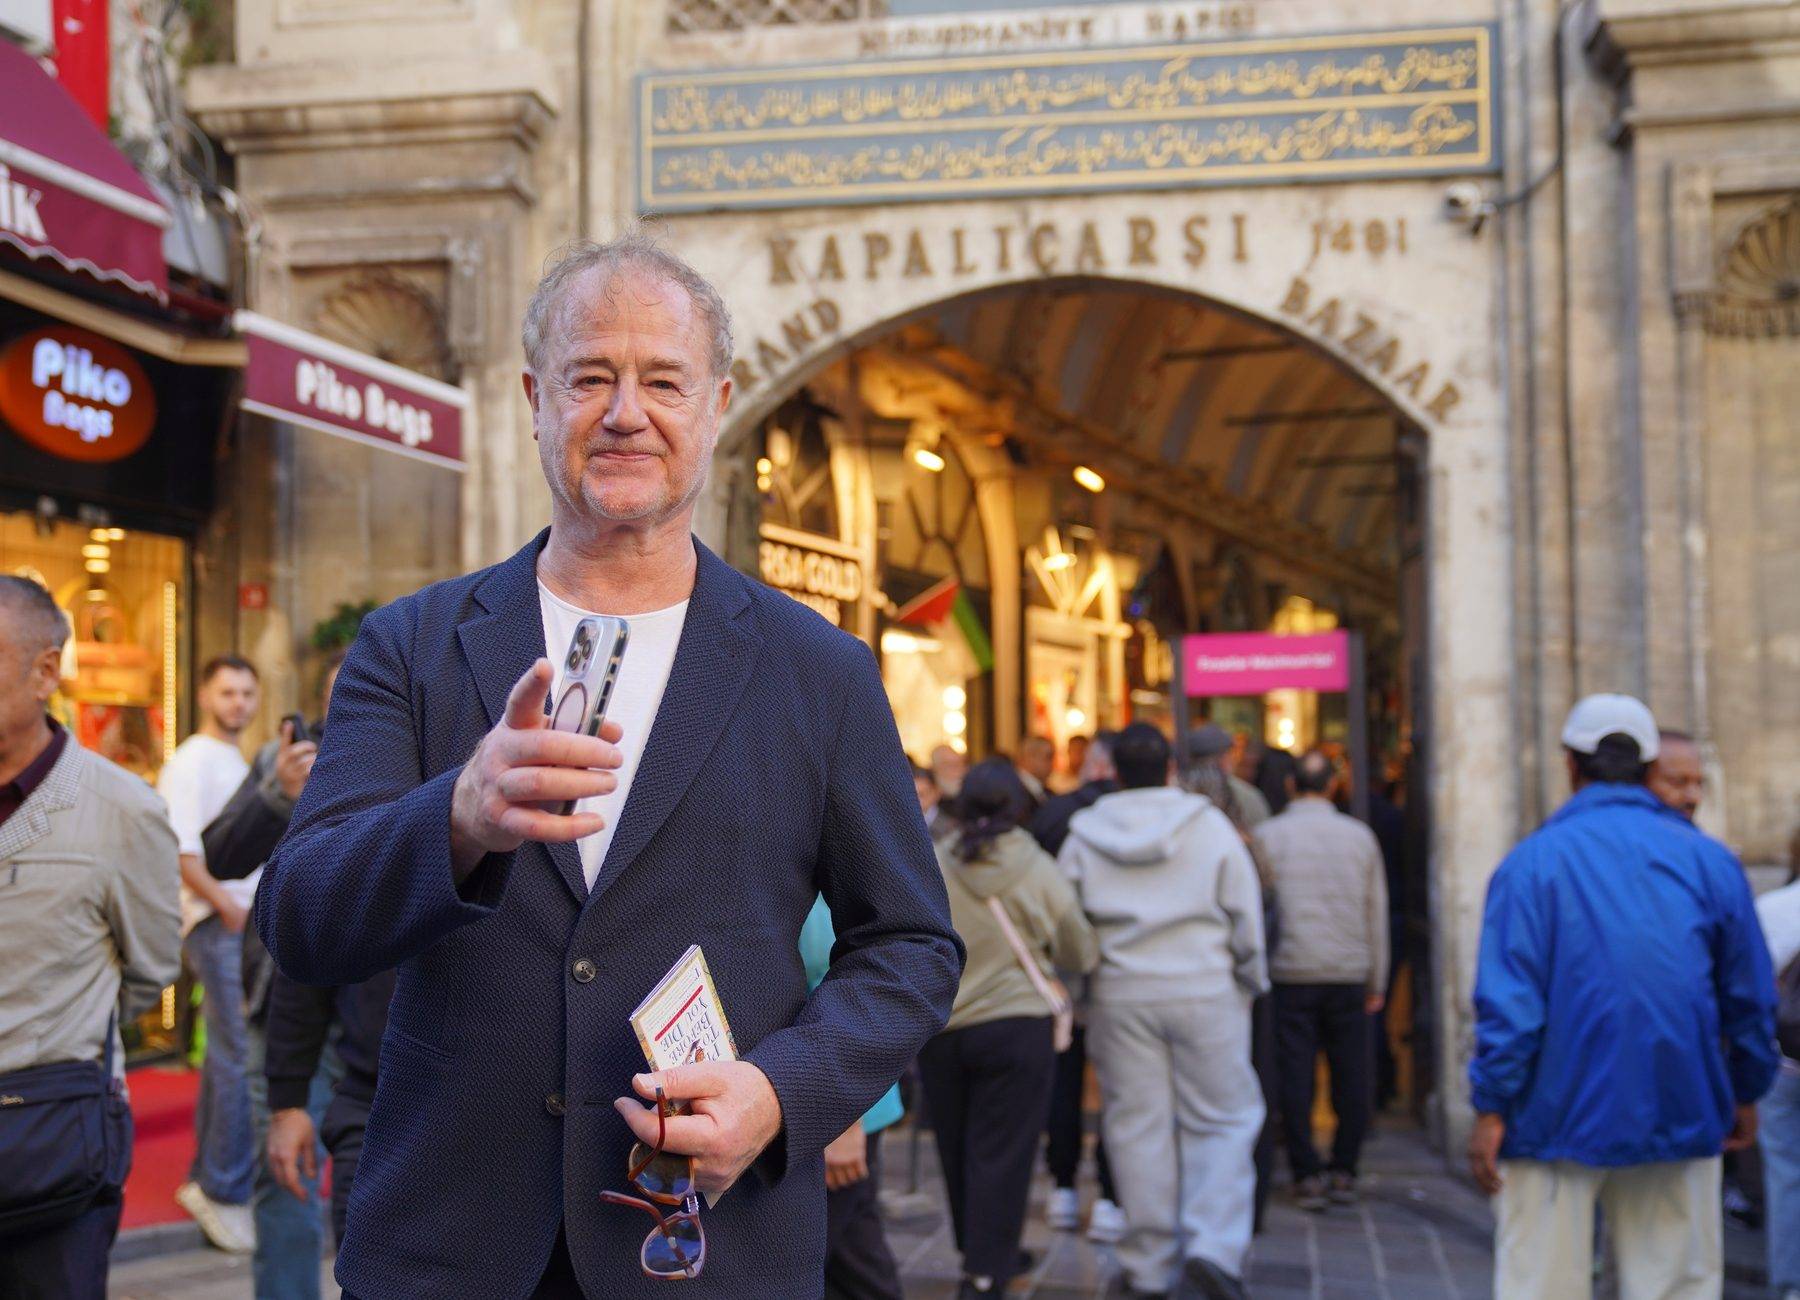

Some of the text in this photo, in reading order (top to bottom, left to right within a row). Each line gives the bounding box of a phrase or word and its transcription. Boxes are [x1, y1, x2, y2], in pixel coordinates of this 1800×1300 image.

[32, 338, 132, 407] Piko
[731, 276, 1461, 424] RAND BAZAAR
[43, 389, 114, 443] Bags
[296, 358, 434, 447] Piko Bags
[803, 551, 862, 602] GOLD
[685, 997, 707, 1022] YOU
[661, 1022, 683, 1052] DIE
